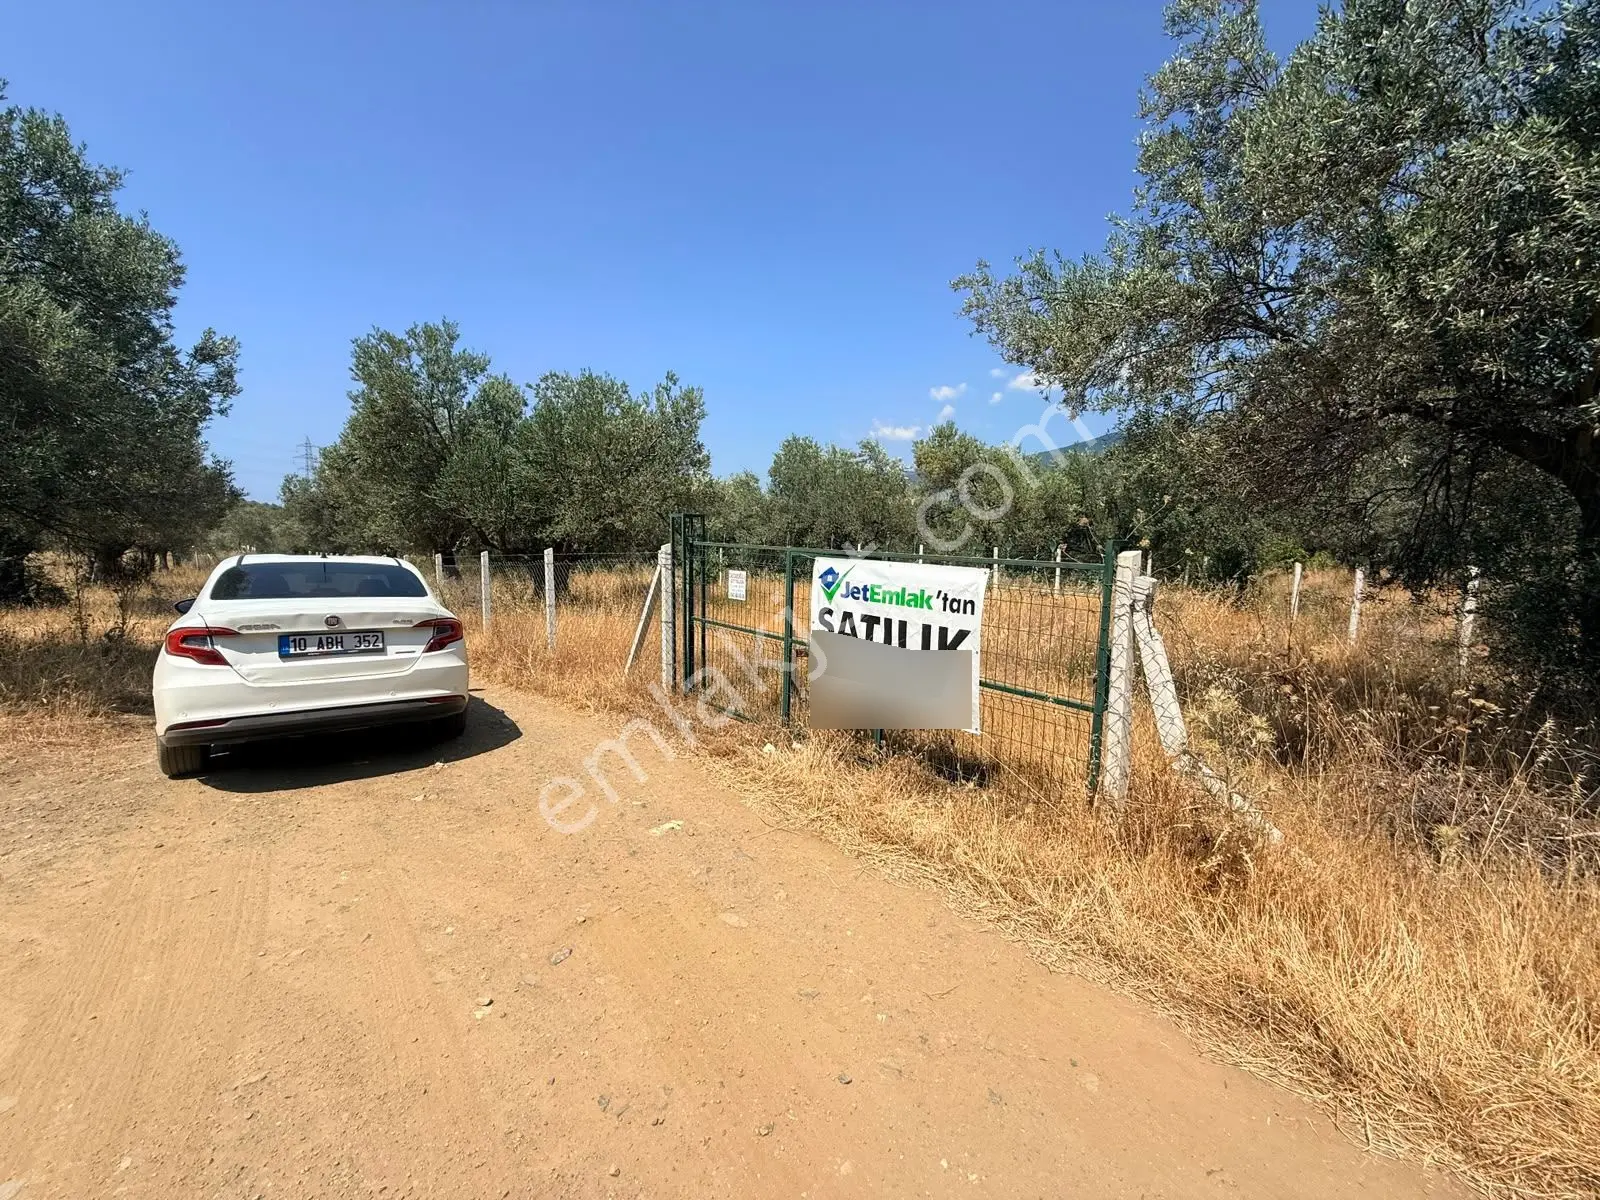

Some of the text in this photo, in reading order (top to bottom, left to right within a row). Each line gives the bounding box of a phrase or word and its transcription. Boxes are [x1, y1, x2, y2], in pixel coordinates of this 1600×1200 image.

[291, 634, 380, 652] 10 ABH 352
